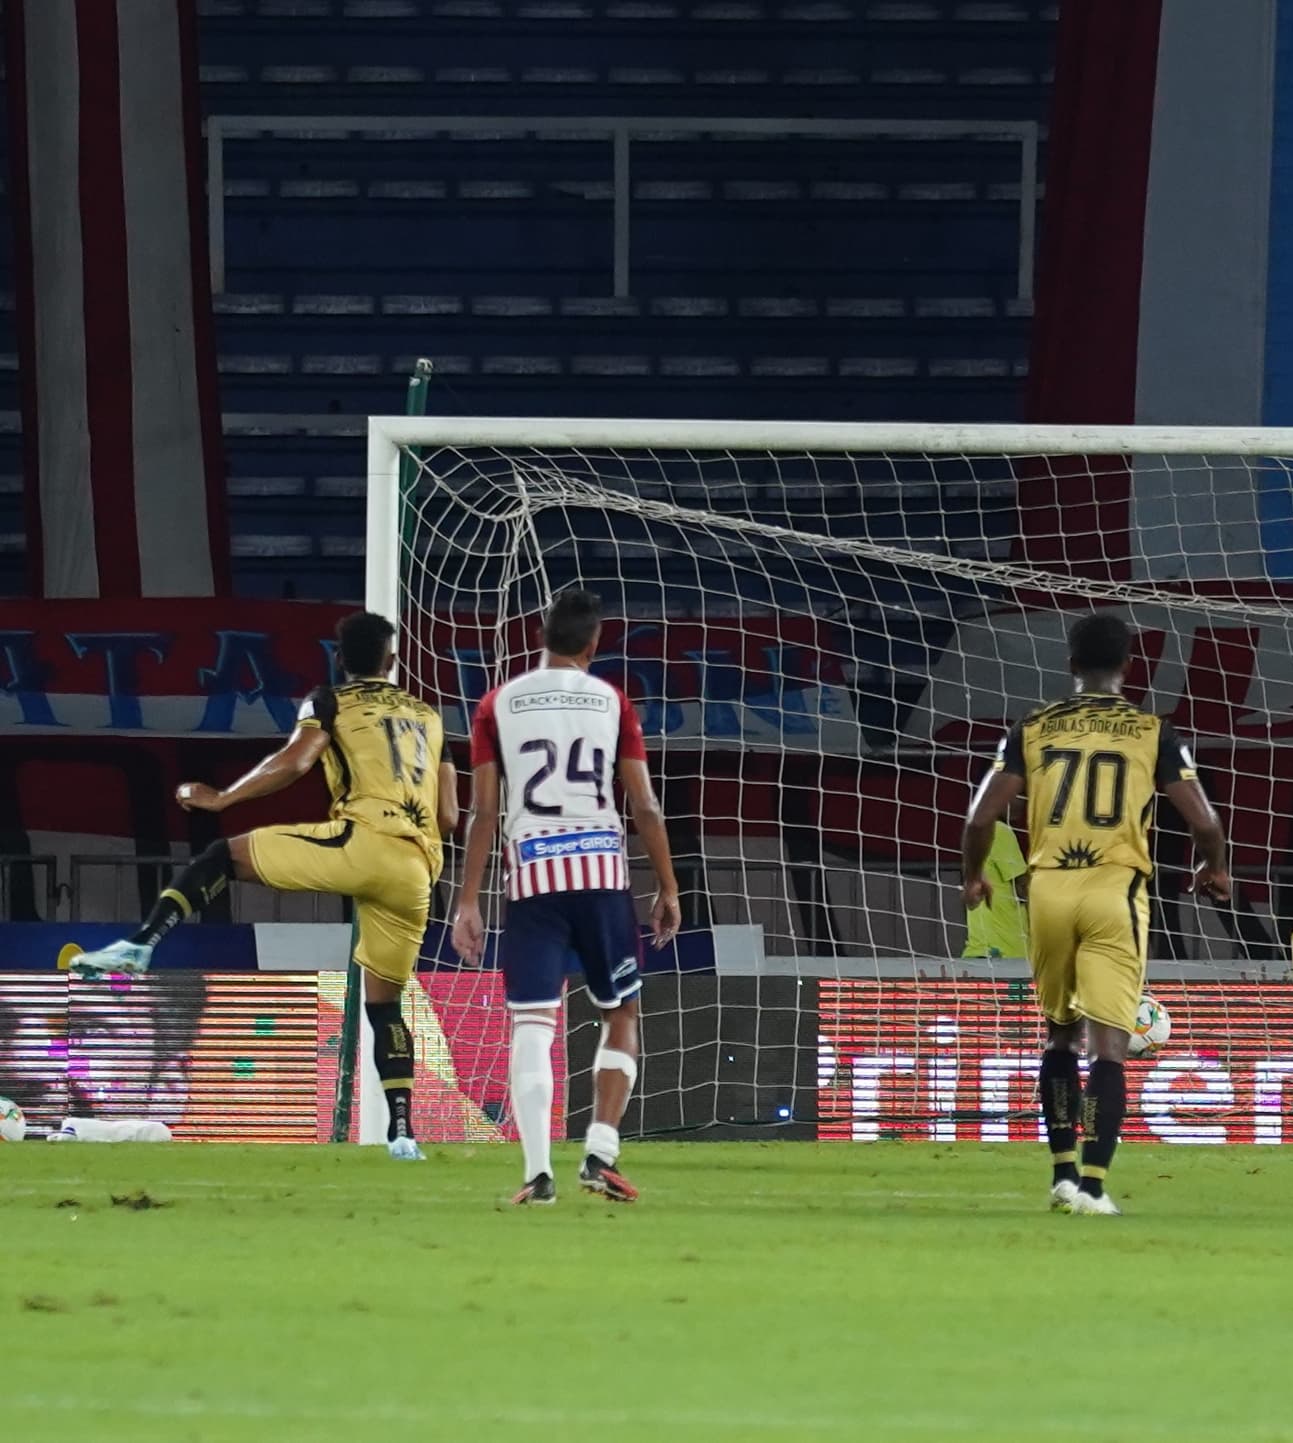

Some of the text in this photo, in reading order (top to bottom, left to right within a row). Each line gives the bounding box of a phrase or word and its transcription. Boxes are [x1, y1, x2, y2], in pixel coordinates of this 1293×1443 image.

[376, 716, 427, 785] 17
[519, 737, 607, 816] 24
[1041, 747, 1128, 830] 70
